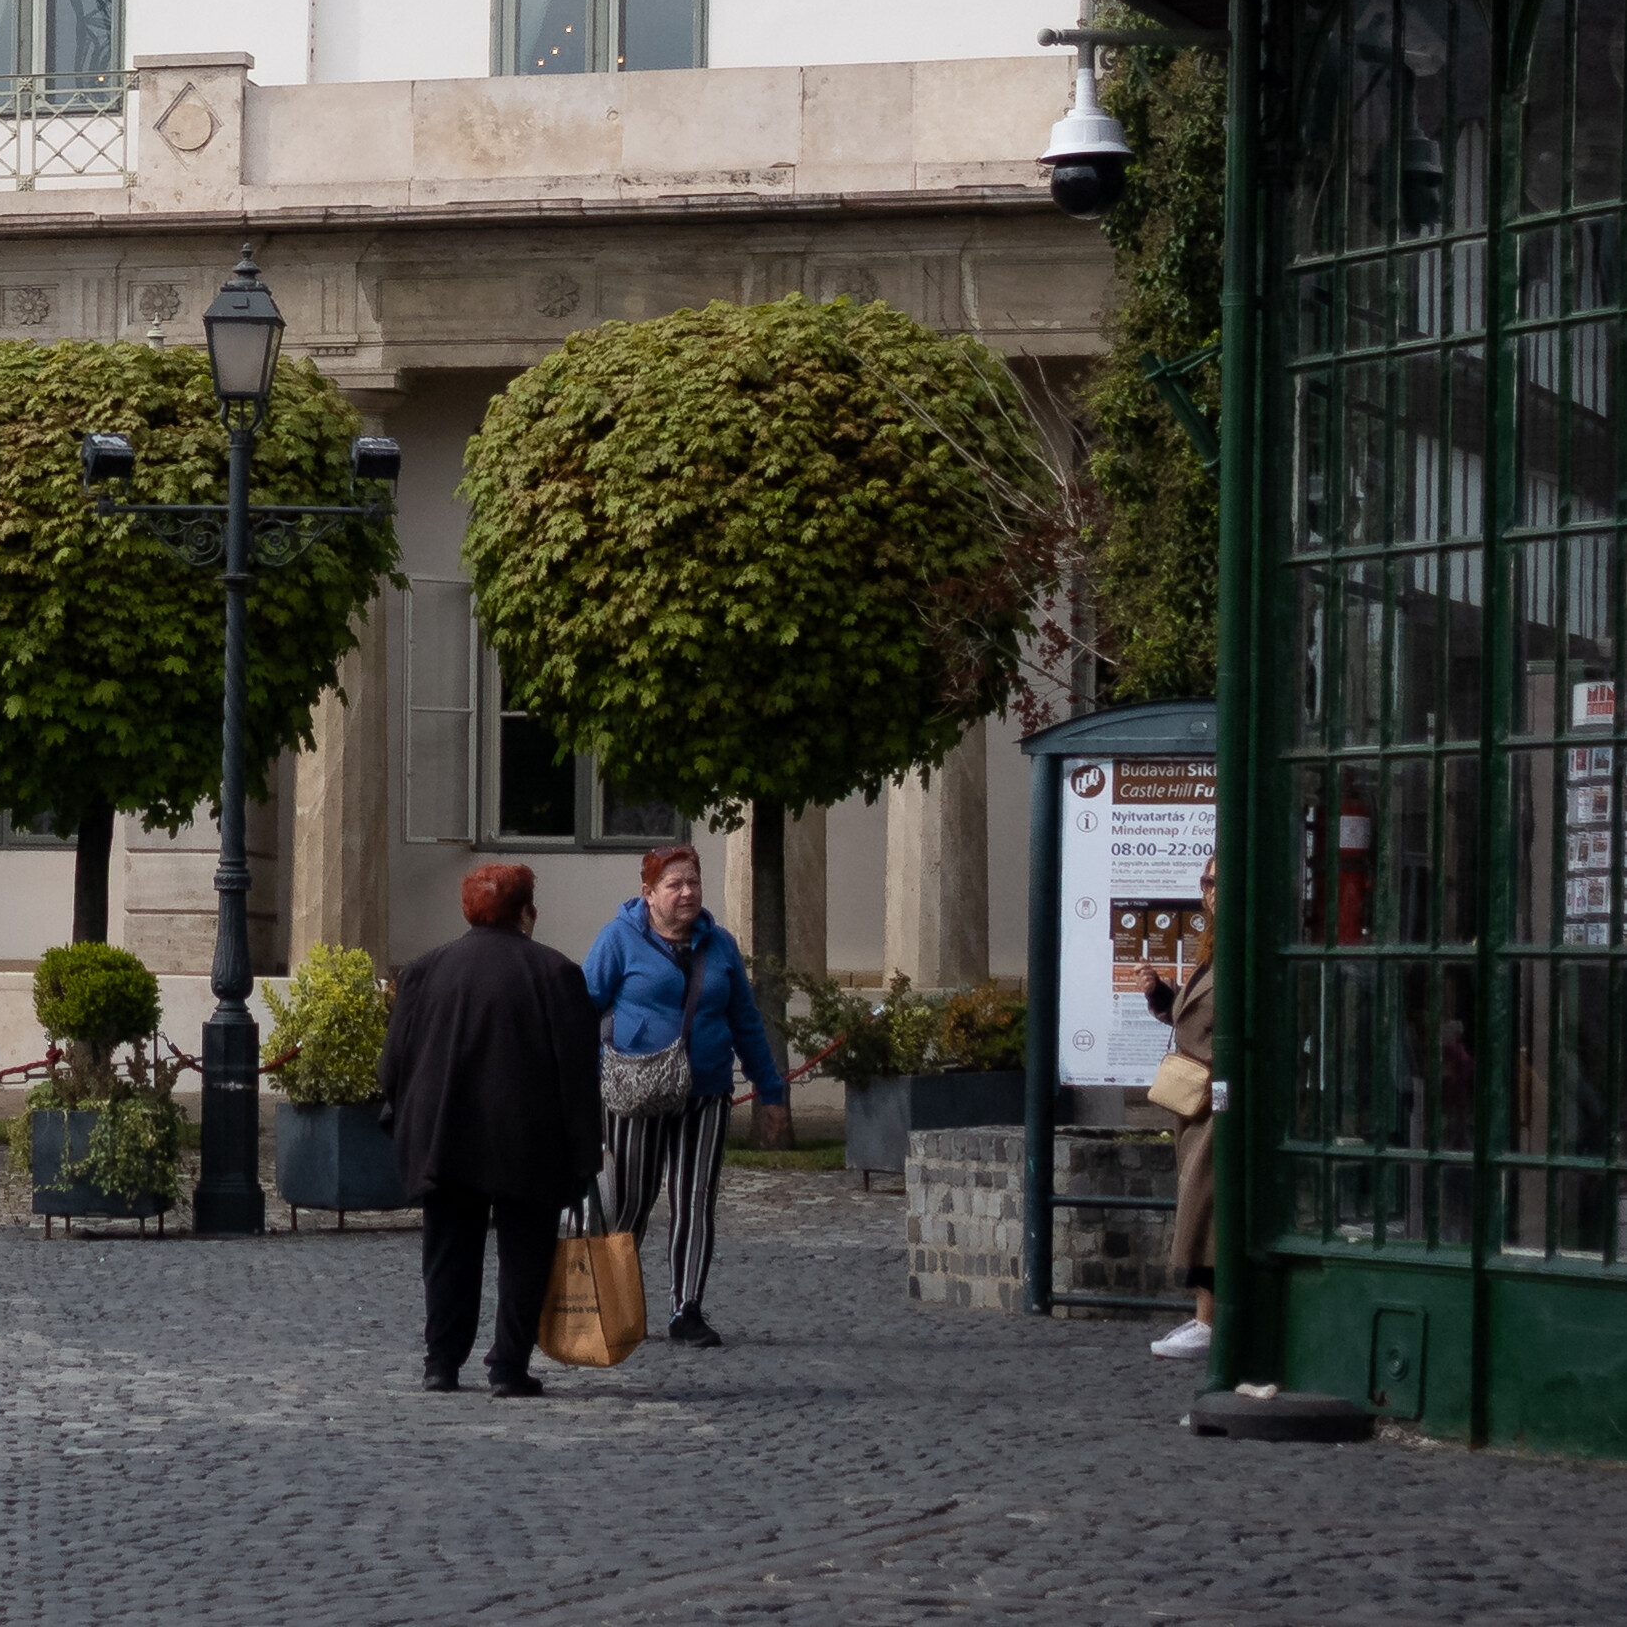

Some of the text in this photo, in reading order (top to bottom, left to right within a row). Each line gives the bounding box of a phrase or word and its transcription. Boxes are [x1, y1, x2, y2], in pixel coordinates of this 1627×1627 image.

[1120, 763, 1184, 777] Budavári
[1120, 783, 1217, 798] Castle Hill Fu
[1111, 811, 1185, 825] Nyitvatartás
[1111, 826, 1179, 838] Mindennap
